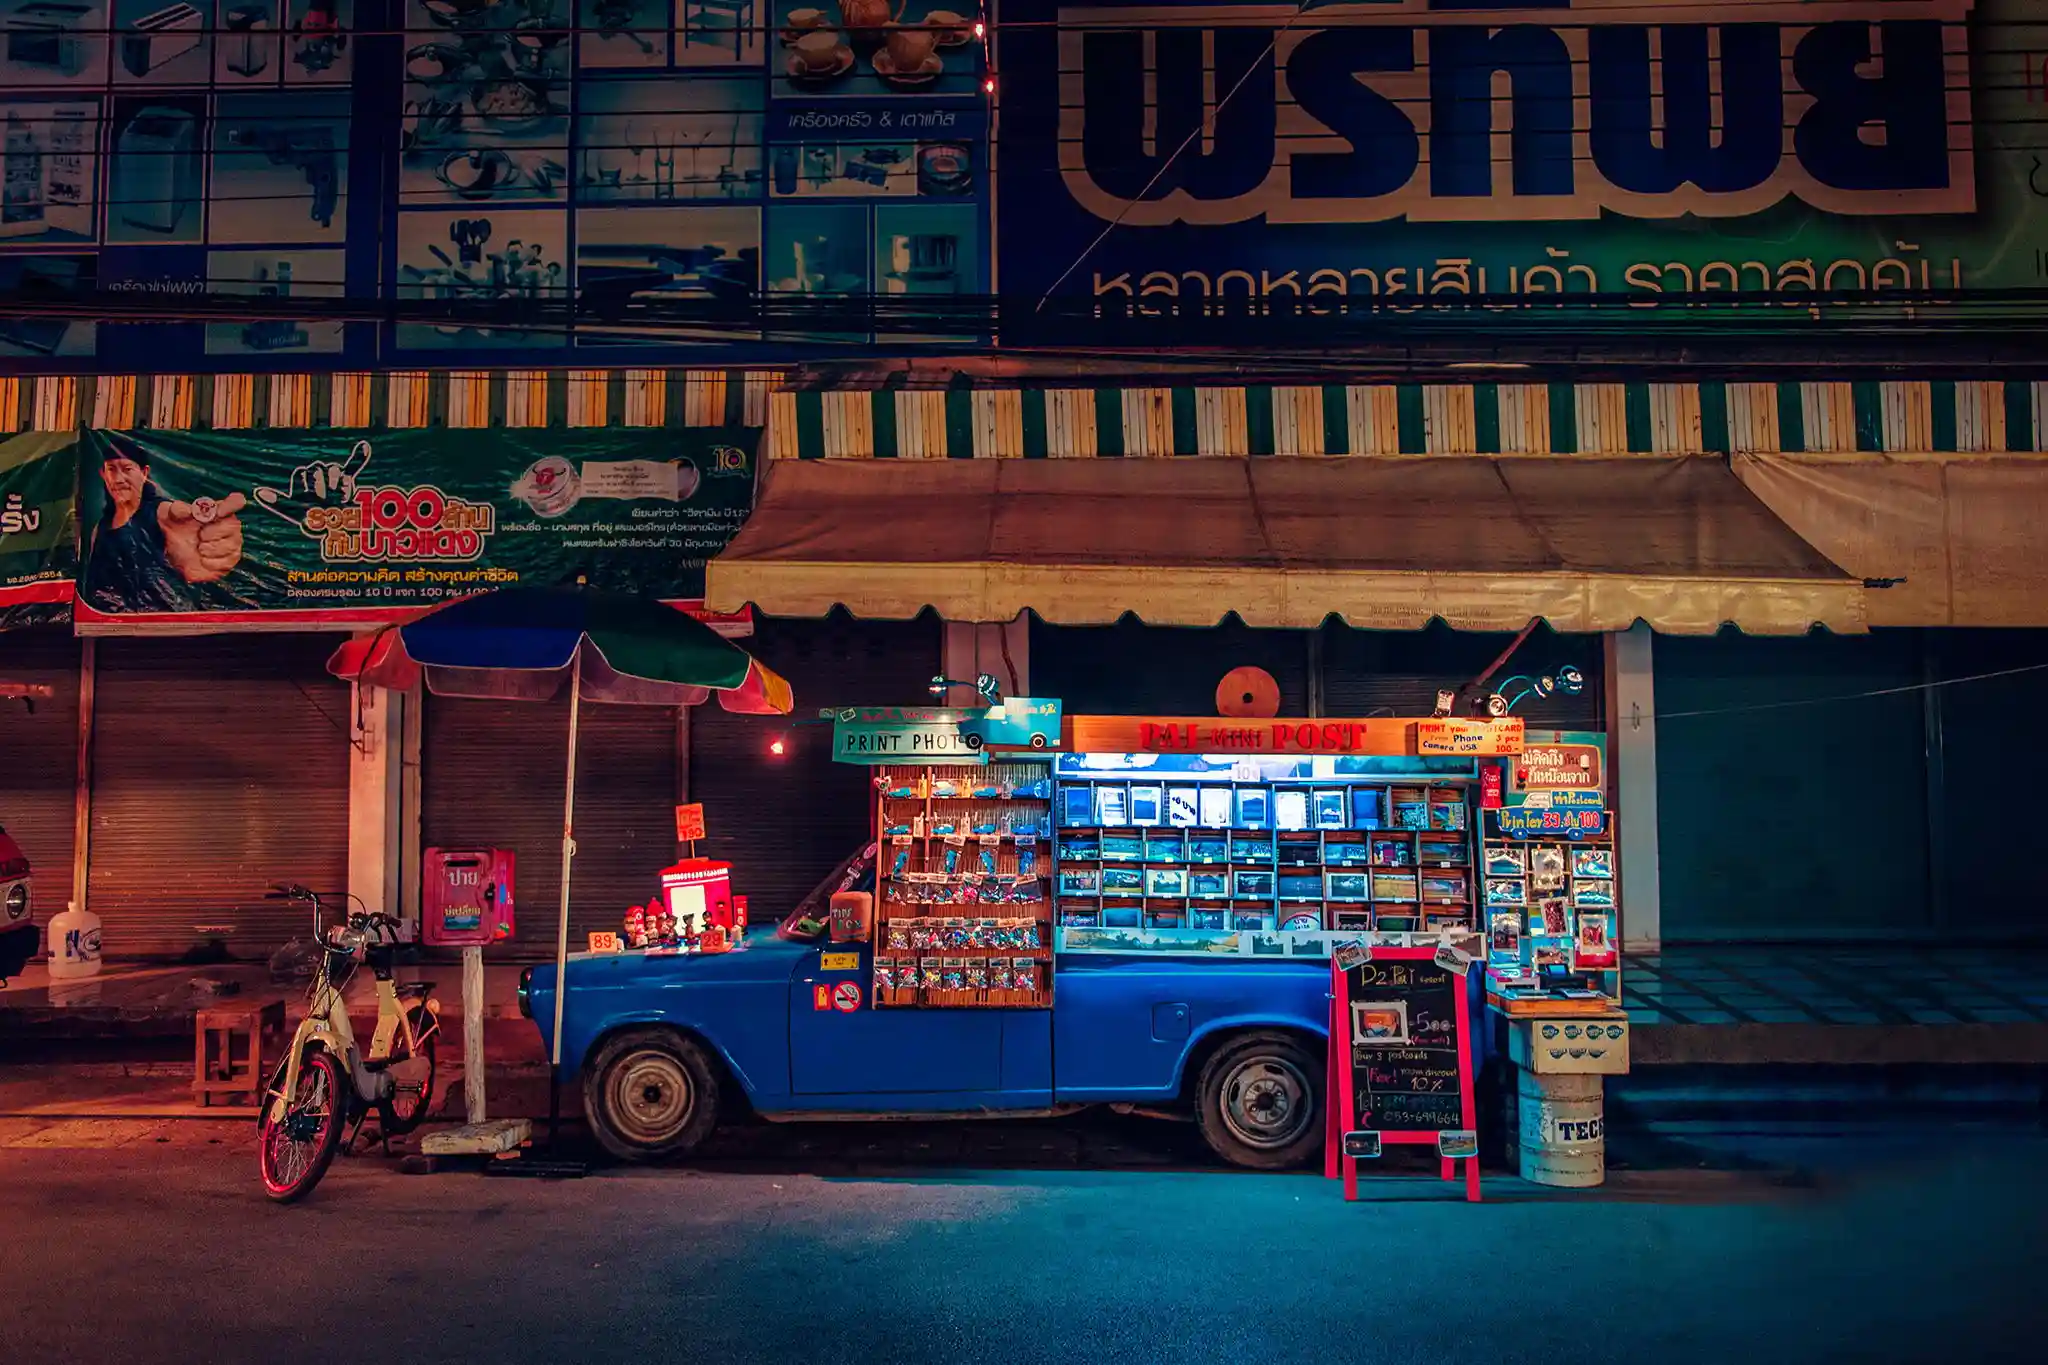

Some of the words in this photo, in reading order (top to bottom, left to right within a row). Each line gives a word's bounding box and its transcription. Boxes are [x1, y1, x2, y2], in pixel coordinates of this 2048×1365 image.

[879, 110, 893, 127] &
[287, 567, 400, 583] สานต่อความคิด
[405, 567, 519, 586] สร้างคุณค่าชีวิต
[420, 587, 443, 597] 100
[1139, 722, 1199, 749] PAI
[1210, 727, 1263, 748] MINI
[1271, 723, 1368, 751] POST
[1419, 724, 1446, 733] PRINT
[847, 734, 901, 751] PRINT
[1423, 740, 1454, 751] Camera
[1453, 734, 1483, 743] Phone
[1578, 811, 1600, 828] 100
[448, 868, 478, 886] ปาย
